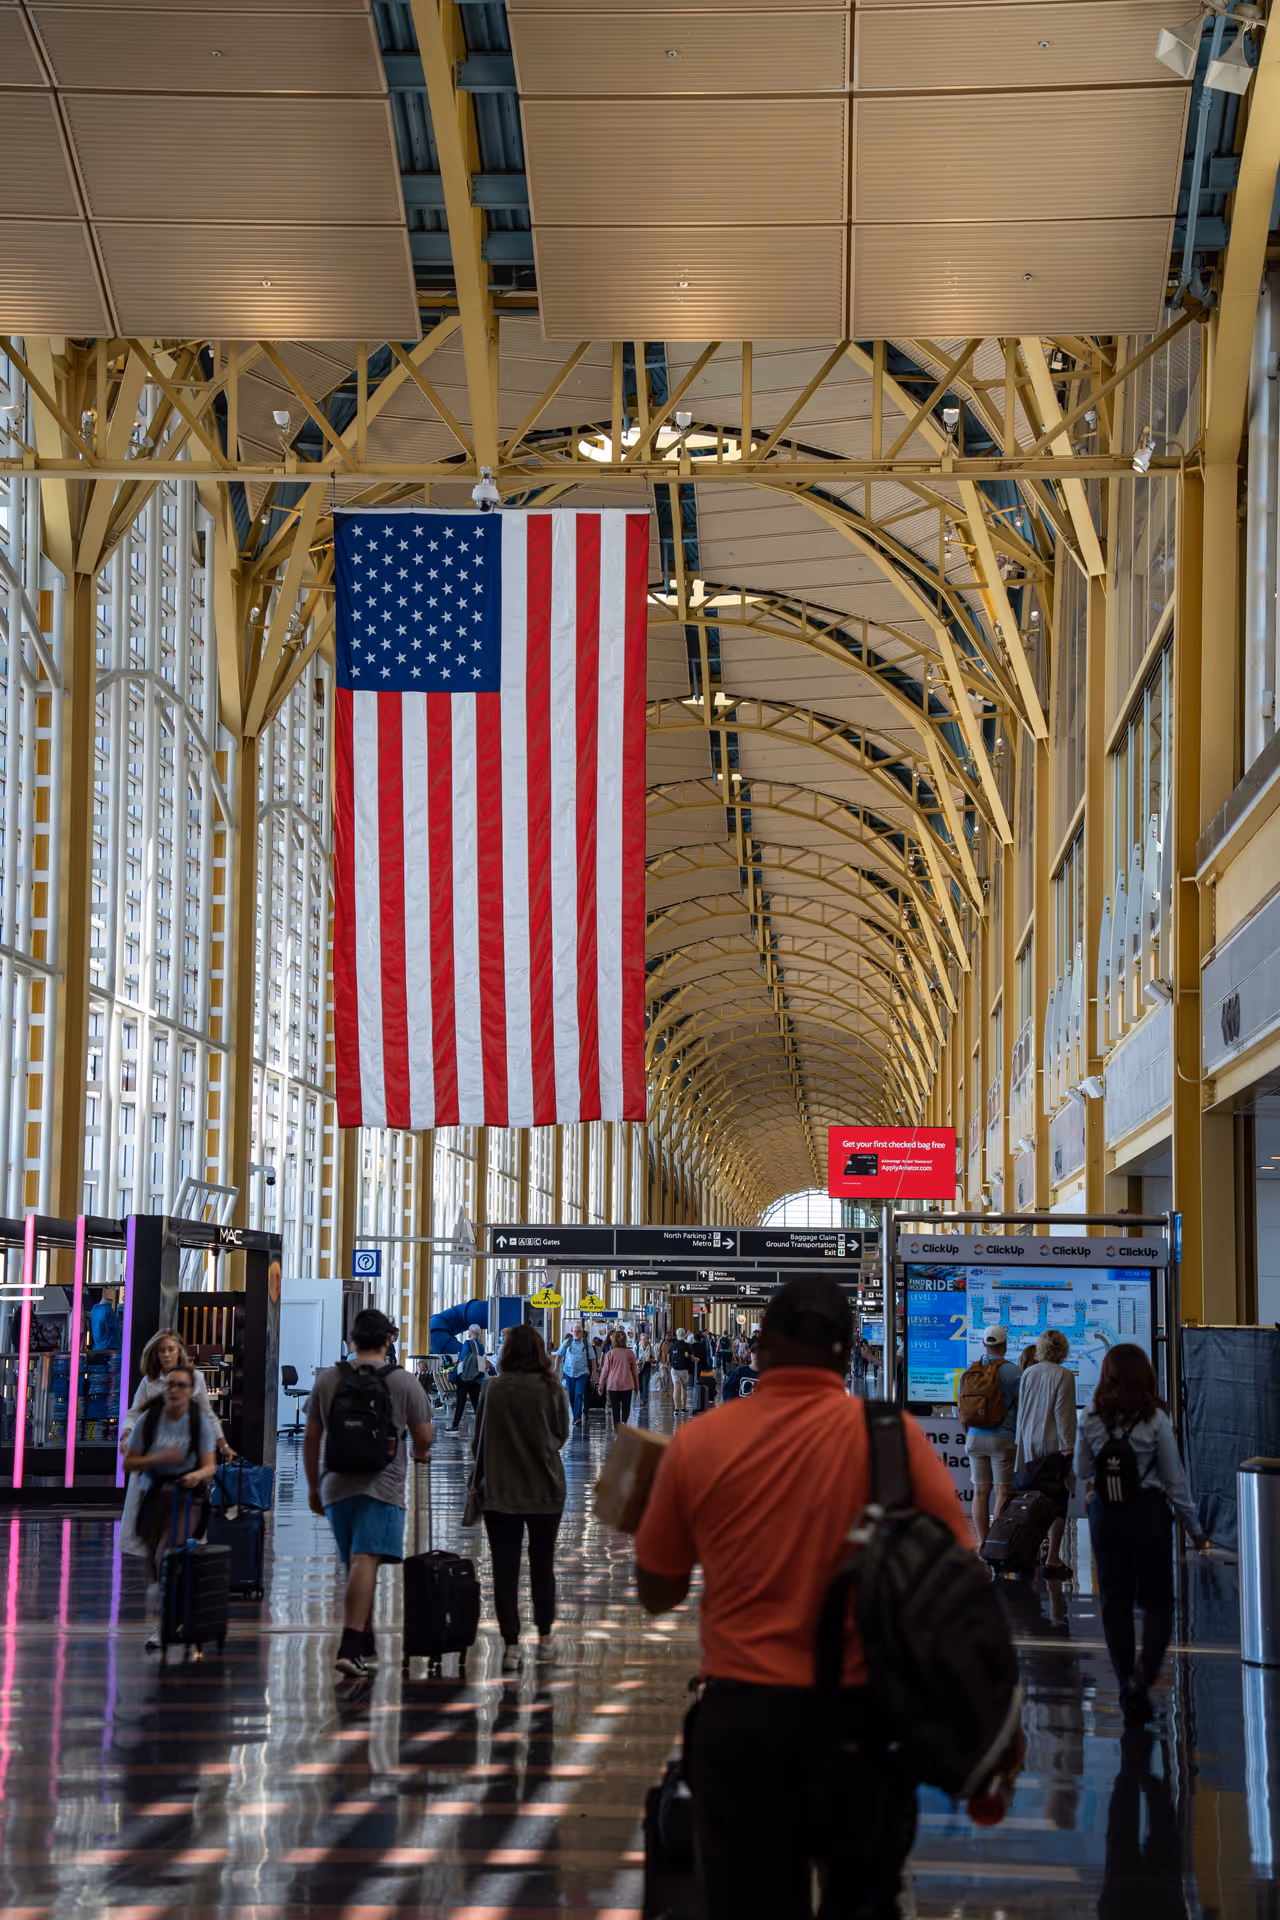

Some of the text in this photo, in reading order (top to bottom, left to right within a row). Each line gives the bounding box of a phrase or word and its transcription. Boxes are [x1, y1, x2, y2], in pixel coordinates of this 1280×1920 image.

[842, 1140, 946, 1150] Get your first checked bag free
[881, 1164, 932, 1172] ApplyAviator.com
[220, 1227, 243, 1245] MAC
[683, 1232, 707, 1240] Parking
[790, 1233, 817, 1241] Baggage
[542, 1238, 560, 1246] Gates
[791, 1241, 837, 1249] Transportation
[922, 1243, 959, 1255] ClickUp
[986, 1244, 1025, 1256] ClickUp
[1052, 1245, 1091, 1257] ClickUp
[1119, 1246, 1158, 1258] ClickUp
[926, 1279, 954, 1291] RIDE
[910, 1293, 931, 1301] LEVEL
[949, 1315, 967, 1340] 2
